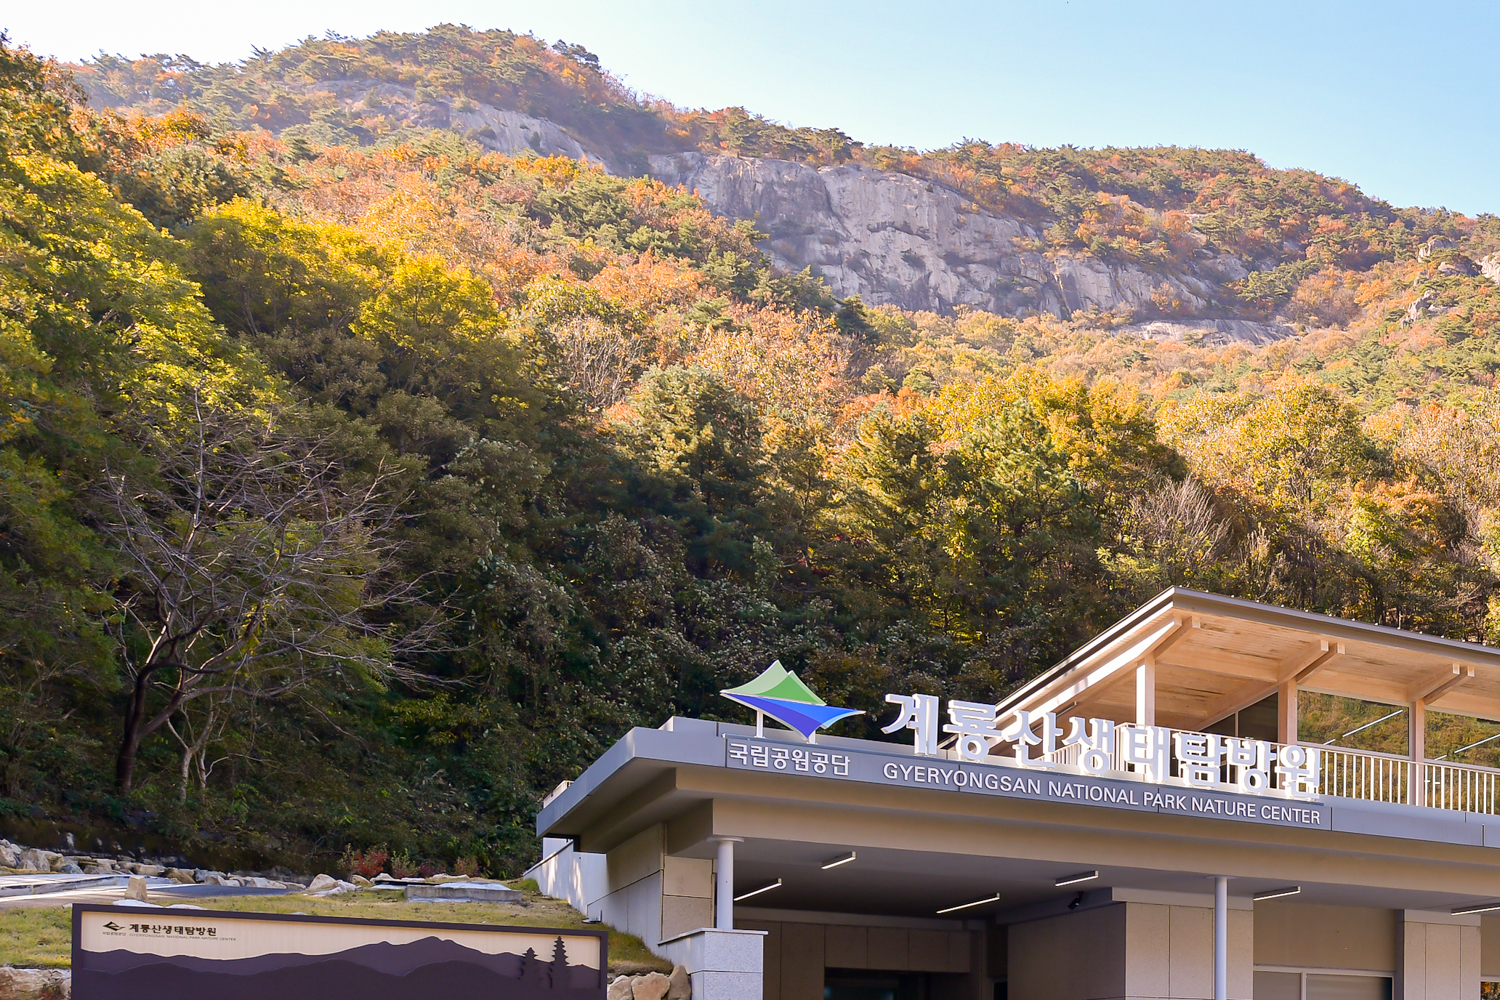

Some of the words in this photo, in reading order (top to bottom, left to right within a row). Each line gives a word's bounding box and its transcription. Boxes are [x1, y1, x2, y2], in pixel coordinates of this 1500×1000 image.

[729, 743, 851, 776] 국립공원공단
[880, 693, 1322, 802] 계룡산생태탐방원
[883, 762, 1041, 795] GYERYONGSAN
[1048, 780, 1139, 806] NATIONAL
[1143, 791, 1188, 812] PARK
[1191, 797, 1257, 818] NATURE
[1260, 805, 1321, 826] CENTER
[129, 923, 217, 937] 계룡산생태탐방원
